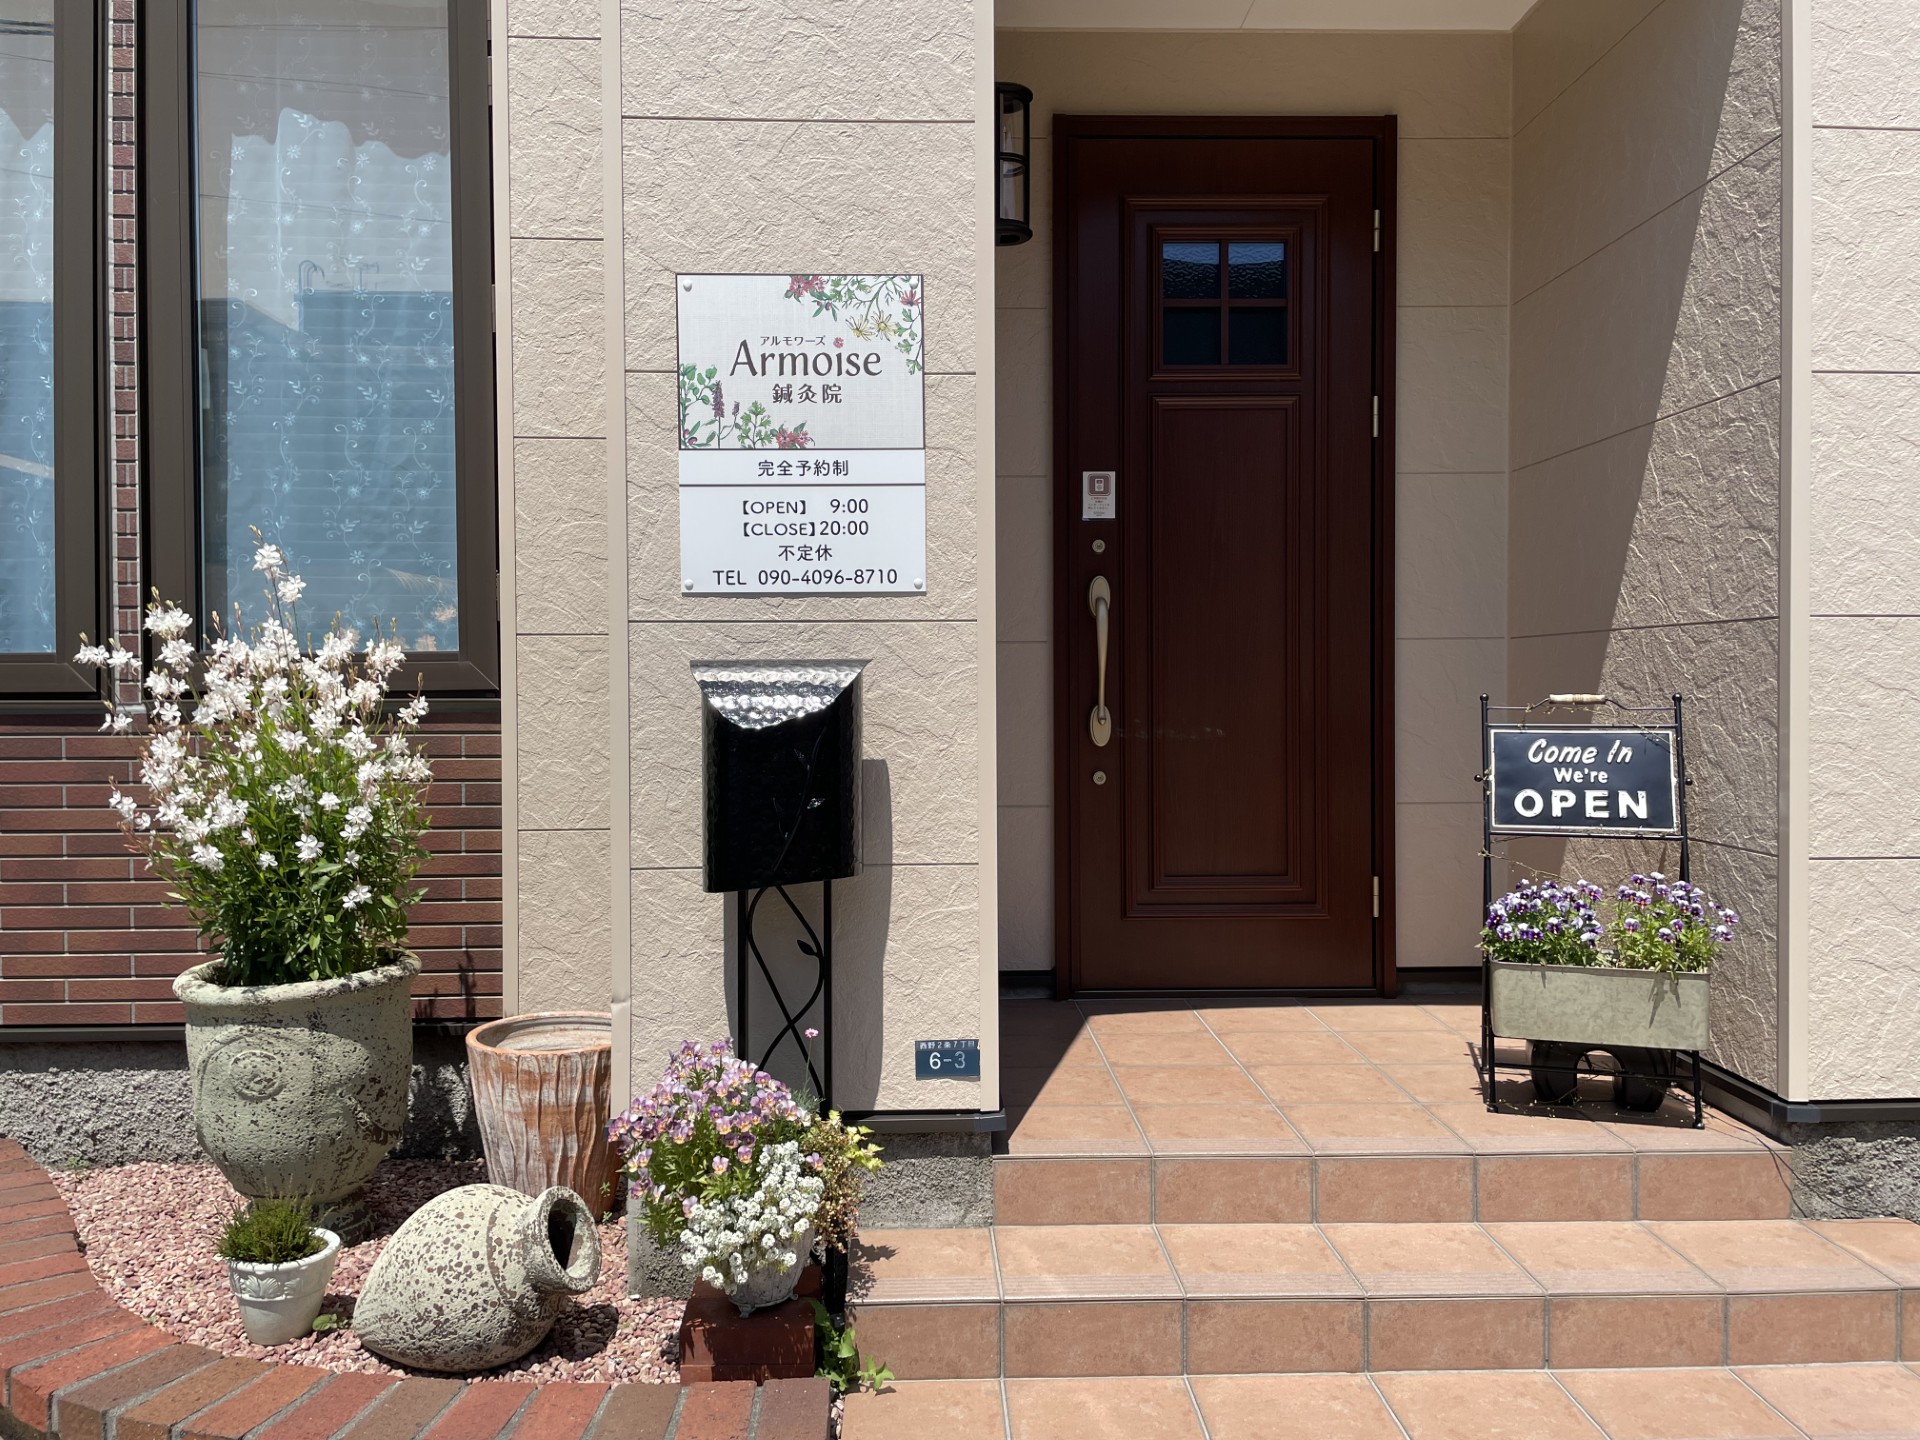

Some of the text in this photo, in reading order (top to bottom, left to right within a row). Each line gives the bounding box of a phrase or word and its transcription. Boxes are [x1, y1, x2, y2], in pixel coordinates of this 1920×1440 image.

[760, 335, 826, 347] アルモワーズ
[729, 339, 883, 377] Armoise
[771, 383, 843, 404] 鍼灸院
[757, 459, 849, 477] 完全予約制
[829, 498, 869, 514] 9:00
[777, 544, 833, 562] 不定休
[712, 568, 898, 586] TEL 090-4096-8710
[1527, 738, 1633, 764] Come In
[1552, 767, 1609, 784] We're
[1513, 788, 1648, 819] OPEN
[929, 1051, 966, 1070] 6-3
